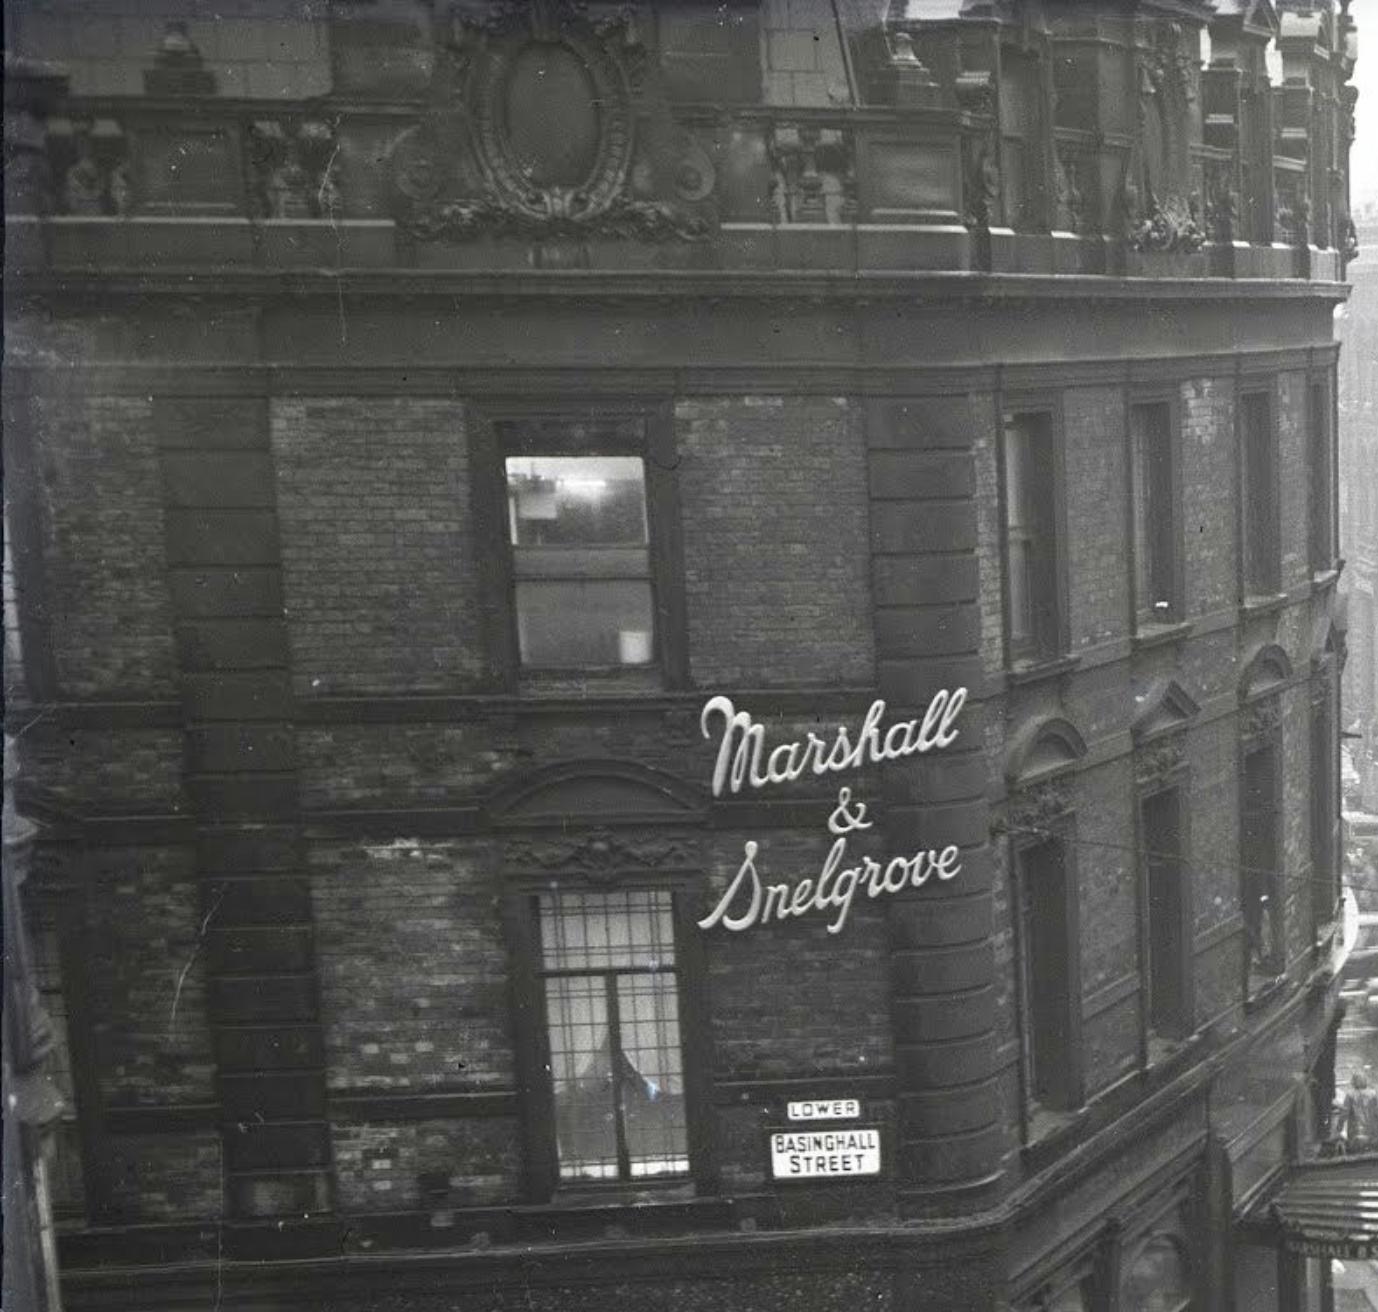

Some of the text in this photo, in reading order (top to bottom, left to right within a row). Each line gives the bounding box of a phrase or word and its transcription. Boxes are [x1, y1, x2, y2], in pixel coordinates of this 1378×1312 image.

[700, 687, 968, 797] Marshall
[828, 786, 872, 833] &
[698, 838, 961, 934] Snelgrove
[791, 1101, 857, 1118] LOWER
[774, 1133, 877, 1157] BASINGHALL
[790, 1154, 865, 1175] STREET
